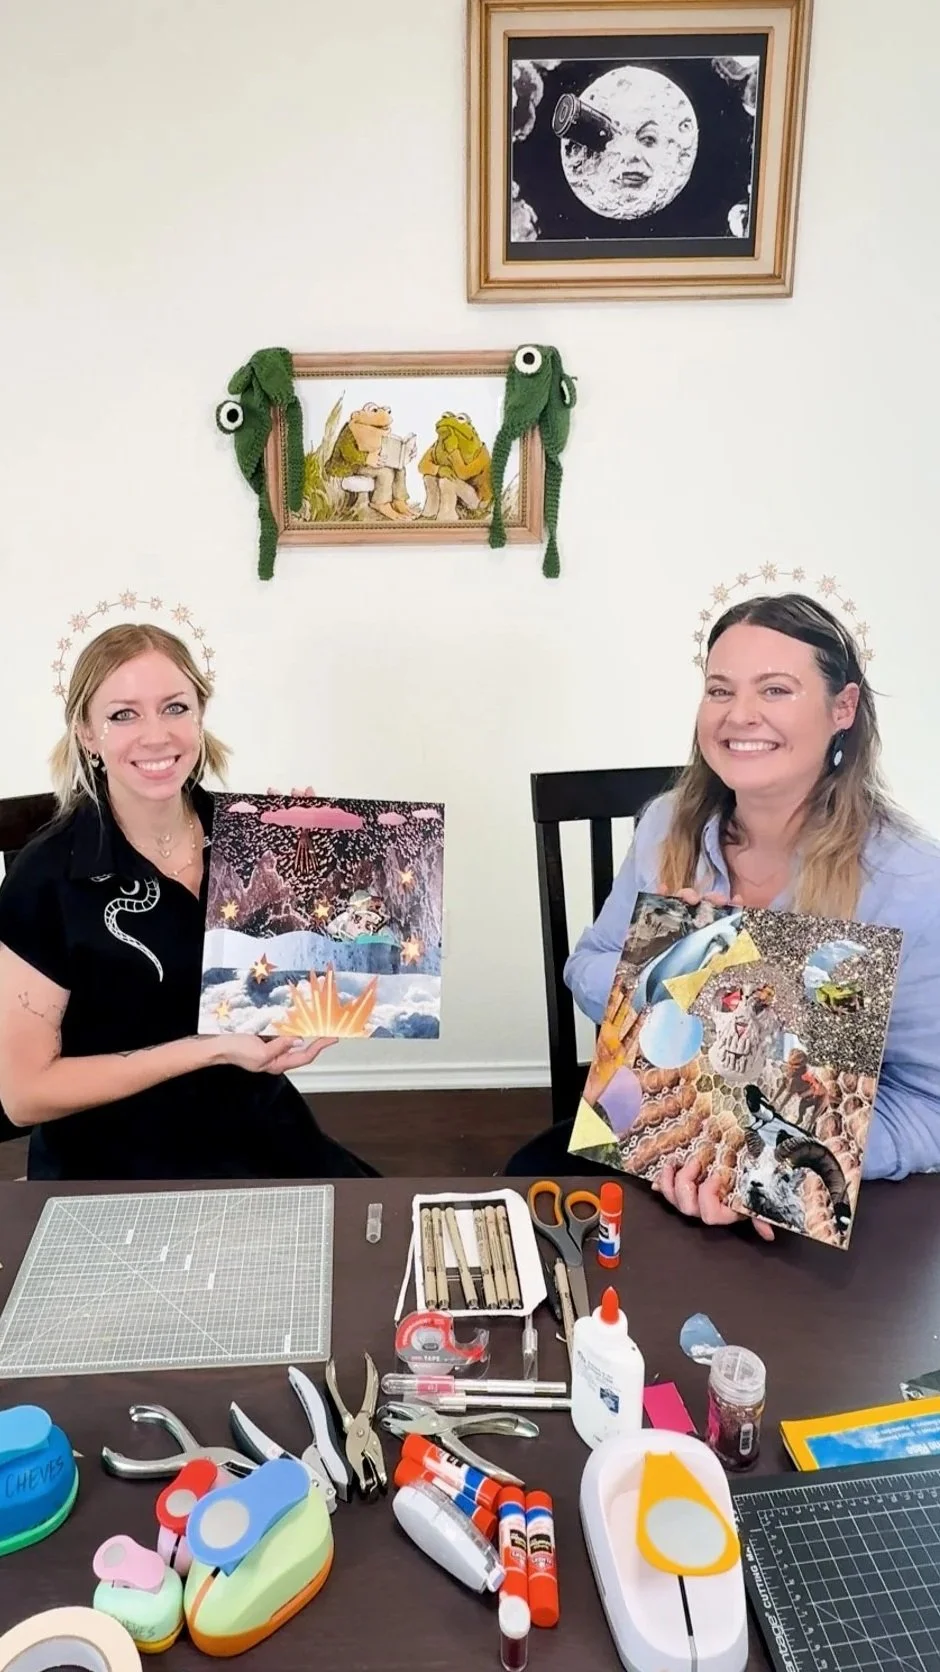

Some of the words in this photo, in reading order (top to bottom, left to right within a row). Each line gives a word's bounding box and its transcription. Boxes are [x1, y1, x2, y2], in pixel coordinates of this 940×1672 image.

[5, 1455, 64, 1499] CHEVES
[744, 1545, 755, 1562] MA
[750, 1564, 772, 1609] CUTTING
